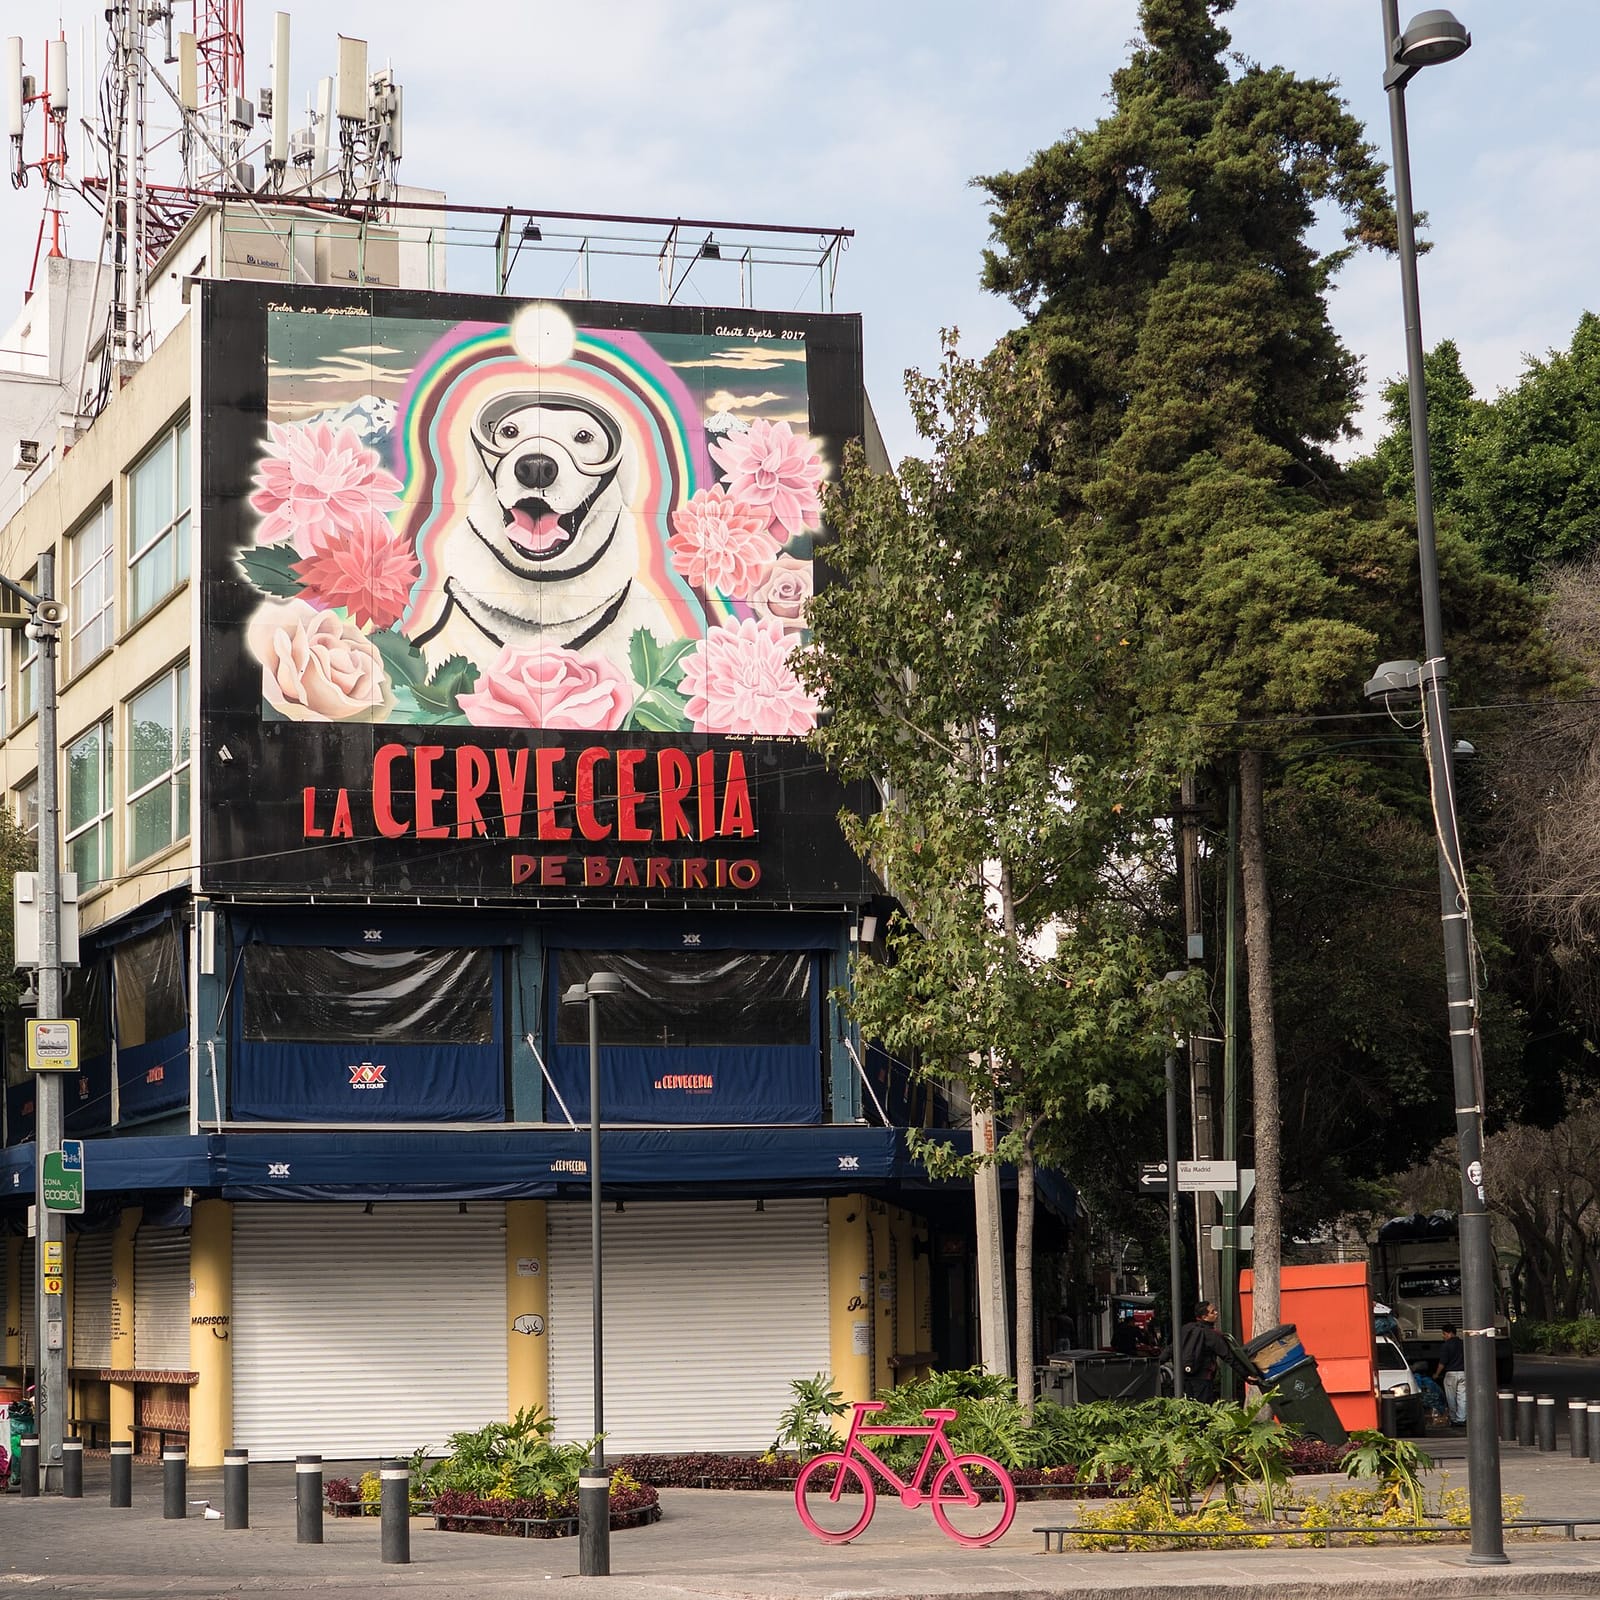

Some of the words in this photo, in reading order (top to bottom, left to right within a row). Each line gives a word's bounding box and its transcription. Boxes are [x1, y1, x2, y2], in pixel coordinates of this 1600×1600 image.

[257, 258, 279, 267] Liebert
[267, 302, 294, 313] Todos
[300, 305, 317, 314] son
[780, 330, 806, 340] 2017
[303, 786, 354, 838] LA
[372, 743, 755, 842] CERVECERIA
[511, 854, 568, 886] DE
[583, 855, 762, 889] BARRIO
[348, 1065, 388, 1084] XX
[654, 1080, 662, 1089] LA
[662, 1074, 713, 1089] CERVECERIA
[44, 1178, 61, 1186] ZONA
